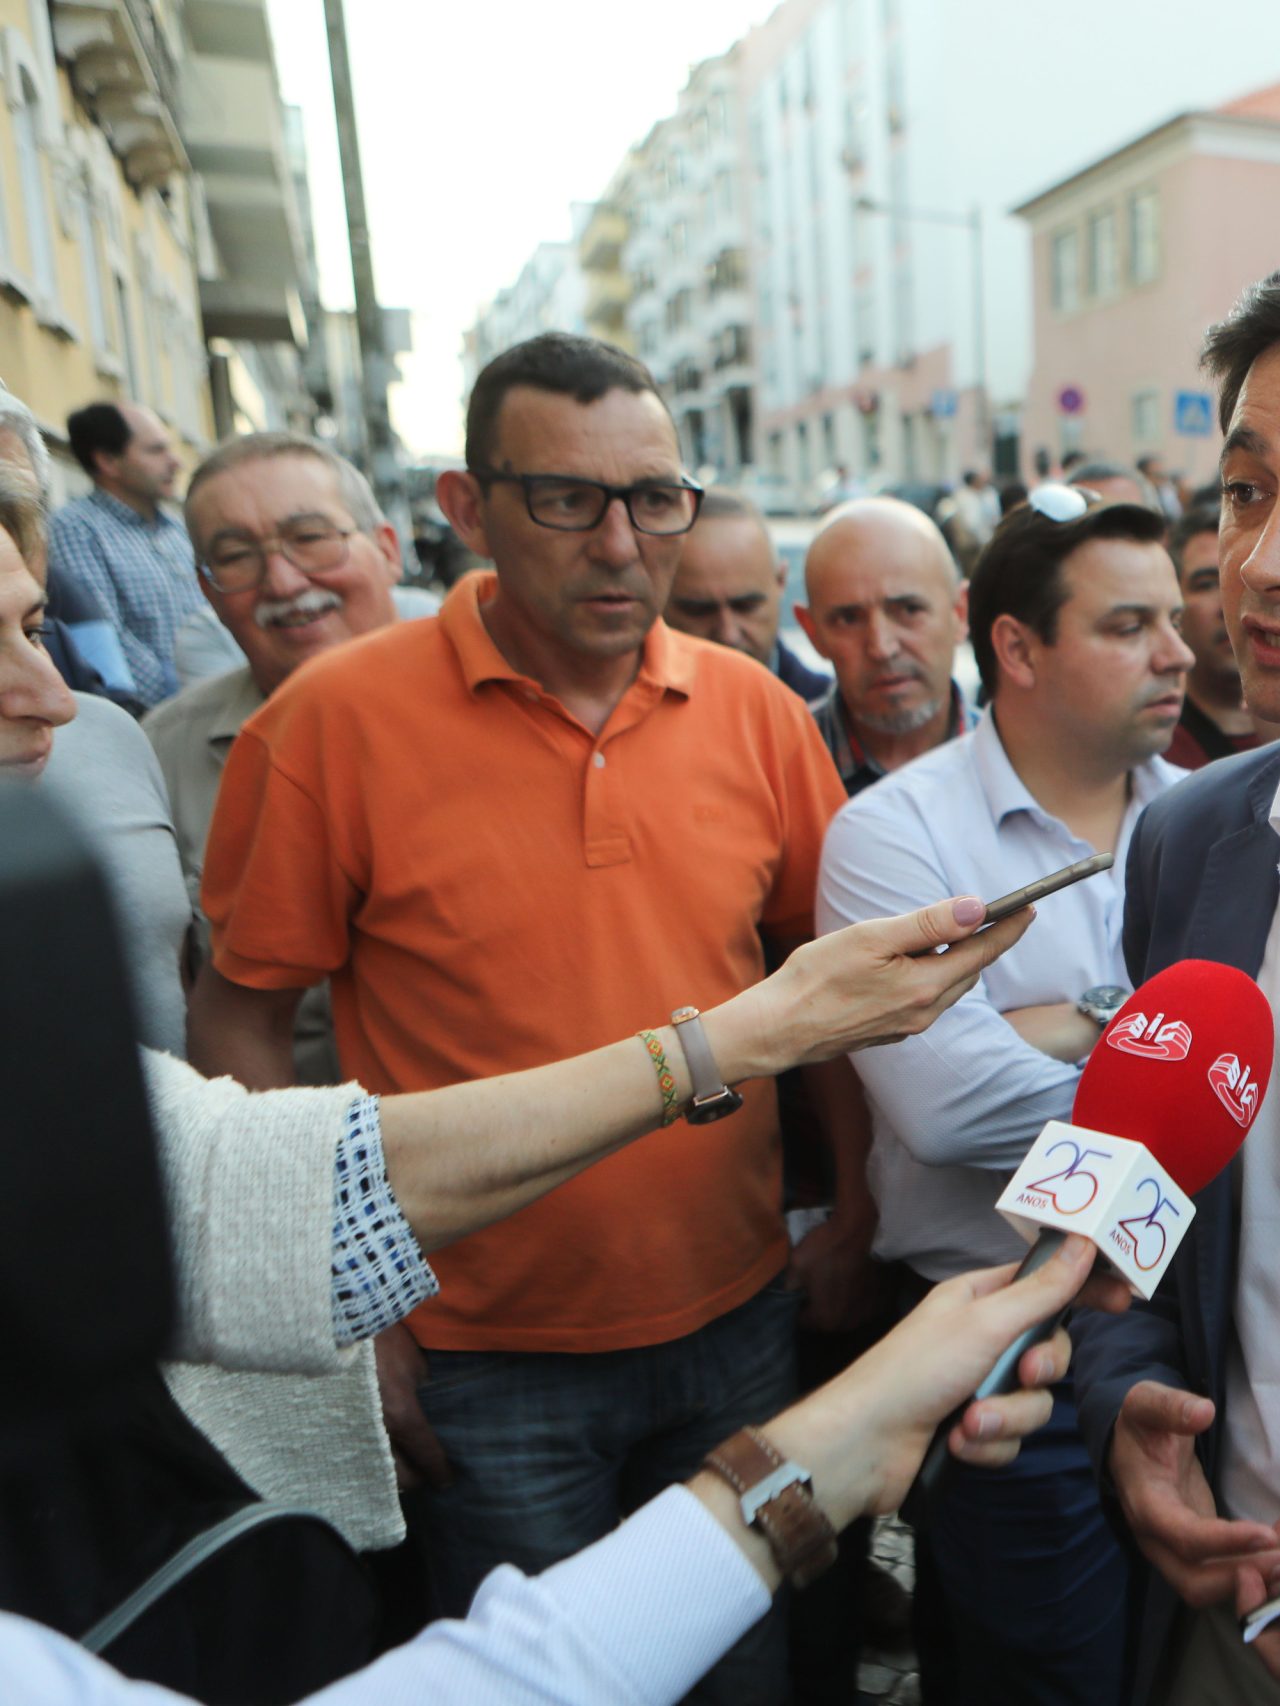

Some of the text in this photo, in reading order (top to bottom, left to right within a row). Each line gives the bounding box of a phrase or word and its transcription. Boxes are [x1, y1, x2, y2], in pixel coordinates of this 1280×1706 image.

[1113, 1012, 1191, 1052] SIC
[1214, 1054, 1258, 1113] SIC
[1016, 1193, 1048, 1209] ANOS
[1026, 1141, 1112, 1215] 25
[1109, 1229, 1131, 1255] ANOS
[1118, 1178, 1180, 1271] 25
